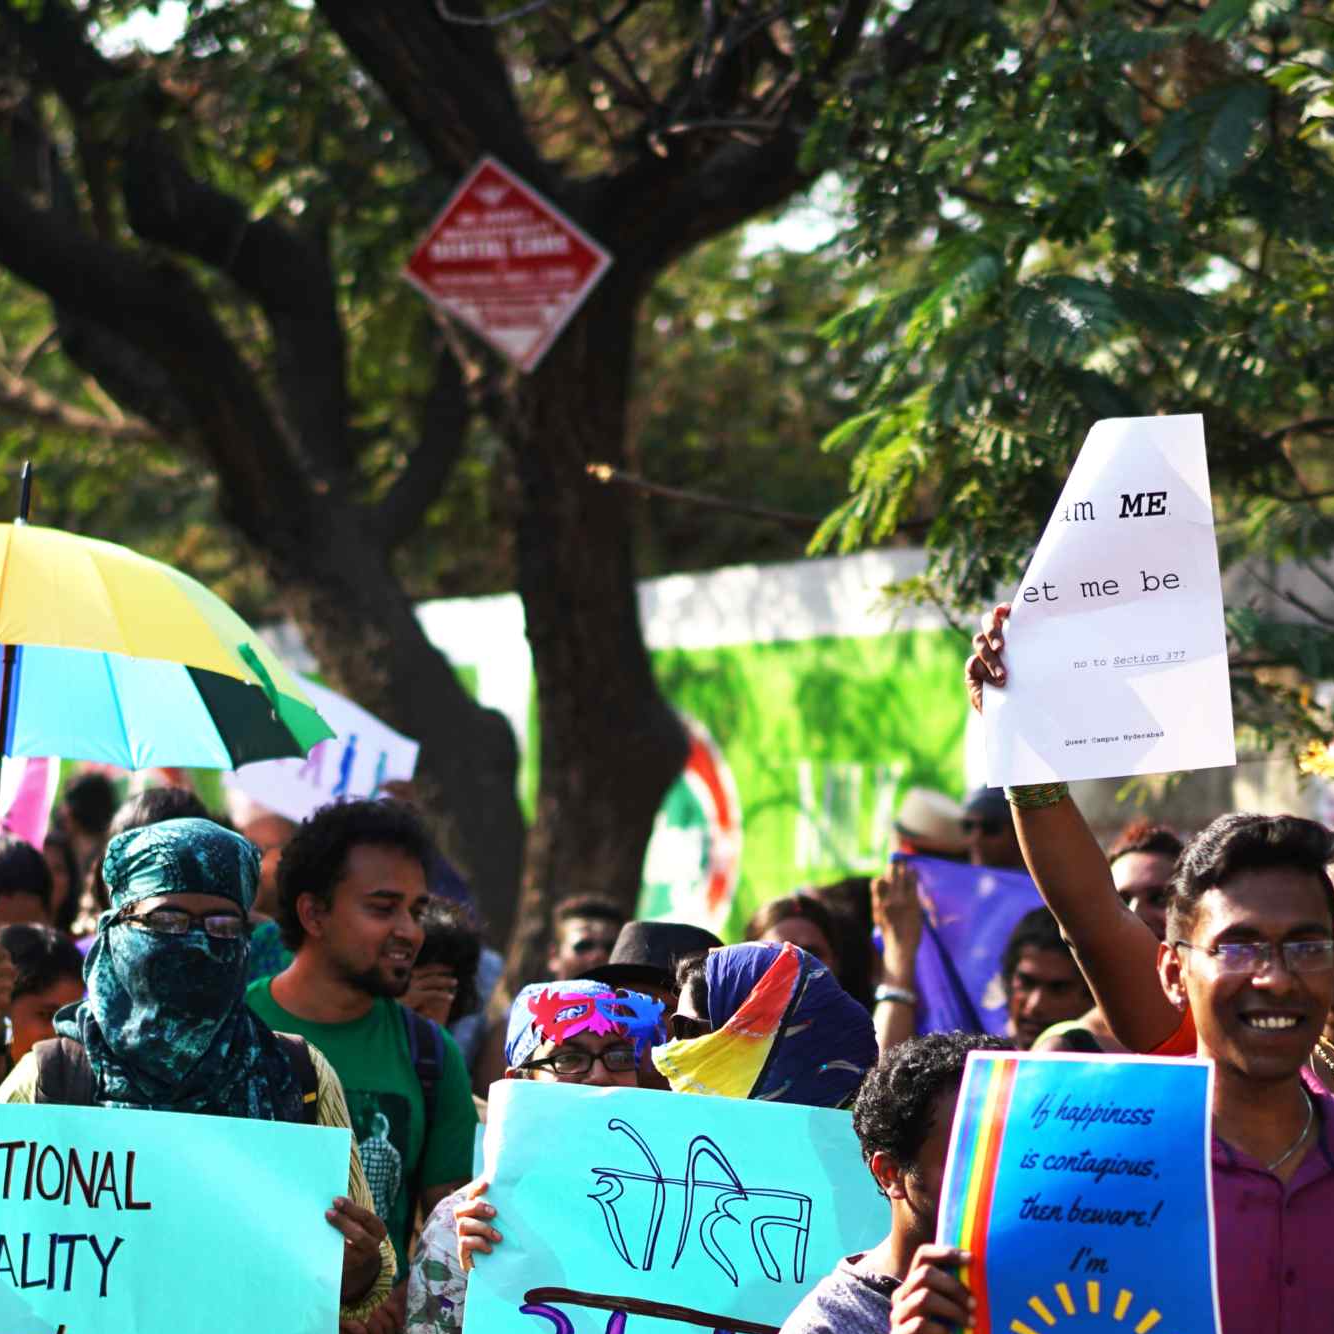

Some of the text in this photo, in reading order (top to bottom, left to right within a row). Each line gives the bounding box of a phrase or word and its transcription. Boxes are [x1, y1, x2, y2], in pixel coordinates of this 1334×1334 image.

[1080, 579, 1119, 598] me
[1113, 653, 1160, 668] Section
[1030, 1093, 1155, 1131] If happiness
[1020, 1148, 1159, 1183] is contagious,
[587, 1118, 813, 1287] रोहित
[1020, 1193, 1164, 1227] then beware!
[1069, 1248, 1109, 1274] I'm
